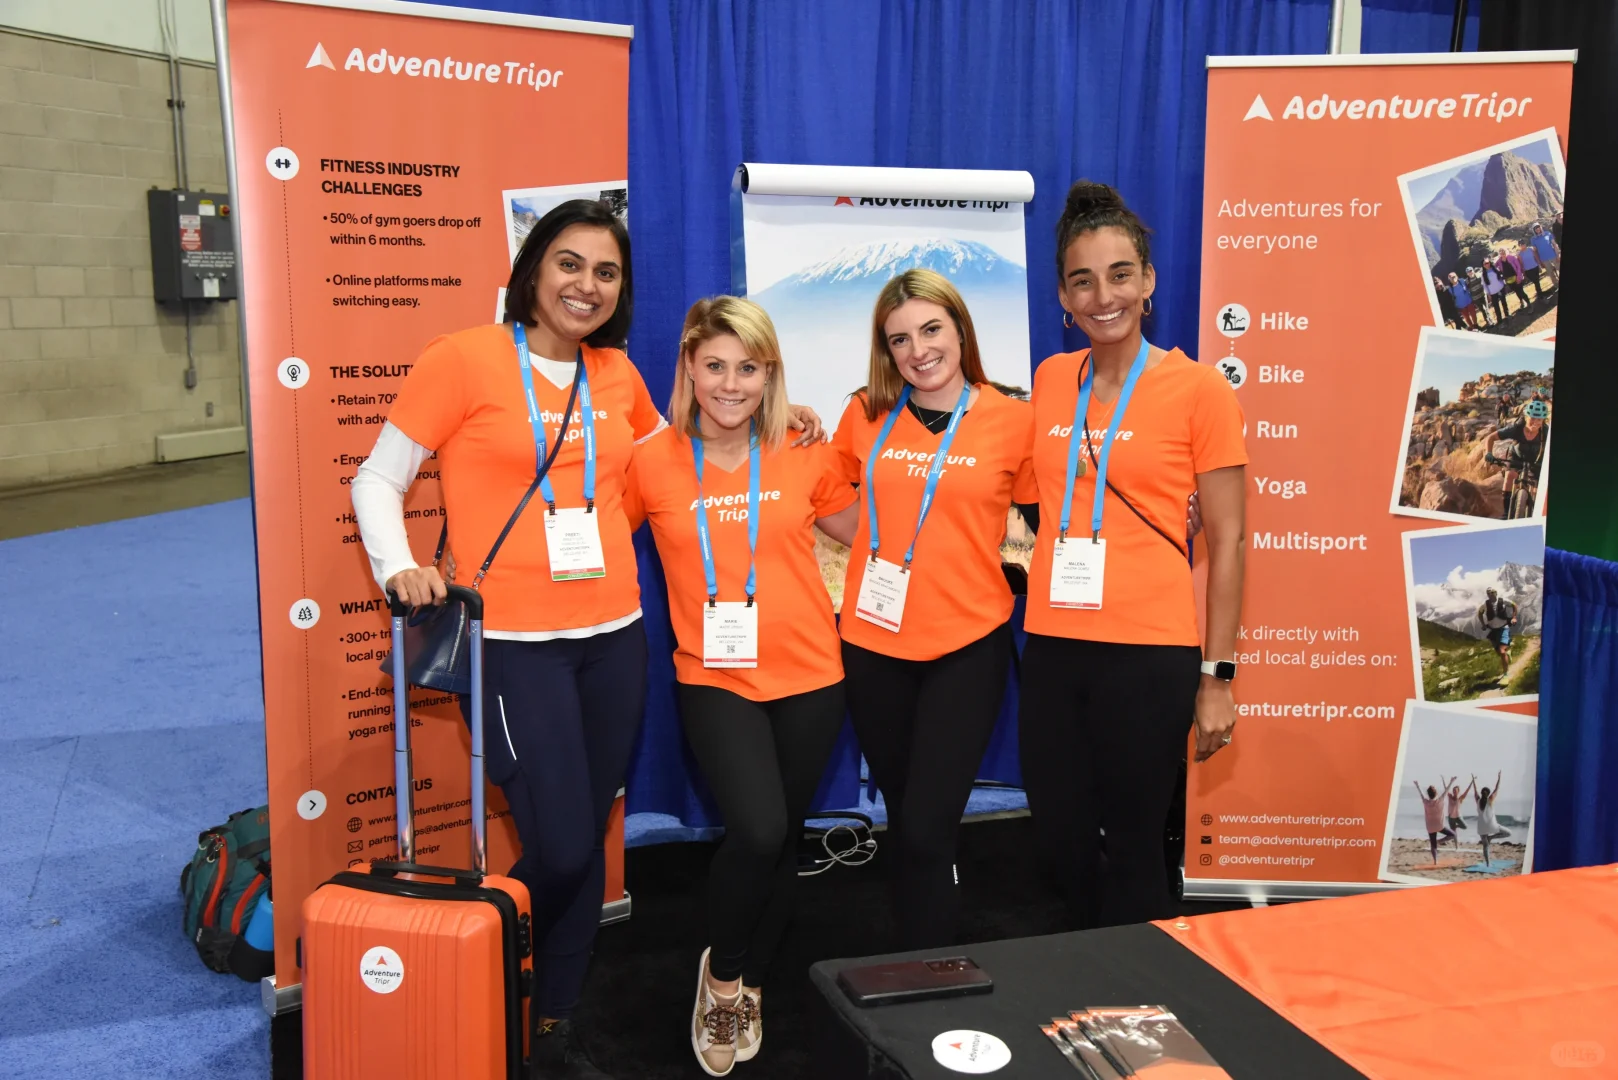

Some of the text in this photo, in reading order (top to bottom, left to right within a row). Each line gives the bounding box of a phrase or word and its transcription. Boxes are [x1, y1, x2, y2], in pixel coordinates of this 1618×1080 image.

[320, 159, 460, 177] FITNESS INDUSTRY
[321, 180, 423, 197] CHALLENGES
[1217, 198, 1382, 218] Adventures for
[330, 213, 481, 229] 50% of gym goers drop off
[330, 233, 426, 246] within 6 months.
[1217, 234, 1318, 254] everyone
[332, 274, 462, 288] Online platforms make
[332, 295, 420, 309] switching easy.
[1260, 312, 1309, 330] Hike
[330, 366, 360, 378] THE
[1258, 365, 1305, 383] Bike
[337, 395, 376, 406] Retain
[337, 414, 362, 425] with
[1257, 421, 1298, 438] Run
[1254, 476, 1308, 499] Yoga
[423, 508, 438, 518] on
[1253, 531, 1368, 555] Multisport
[340, 599, 382, 615] WHAT
[346, 632, 378, 644] 300+
[1252, 626, 1318, 645] directly
[1322, 627, 1359, 642] with
[346, 649, 373, 662] local
[1265, 651, 1306, 665] local
[1310, 651, 1366, 669] guides
[1370, 654, 1397, 667] on:
[348, 704, 391, 720] running
[349, 726, 376, 740] yoga
[414, 778, 433, 791] US
[1219, 814, 1365, 828] www.adventuretripr.com
[1219, 835, 1376, 849] team@adventuretripr.com
[1218, 854, 1315, 868] @adventuretripr
